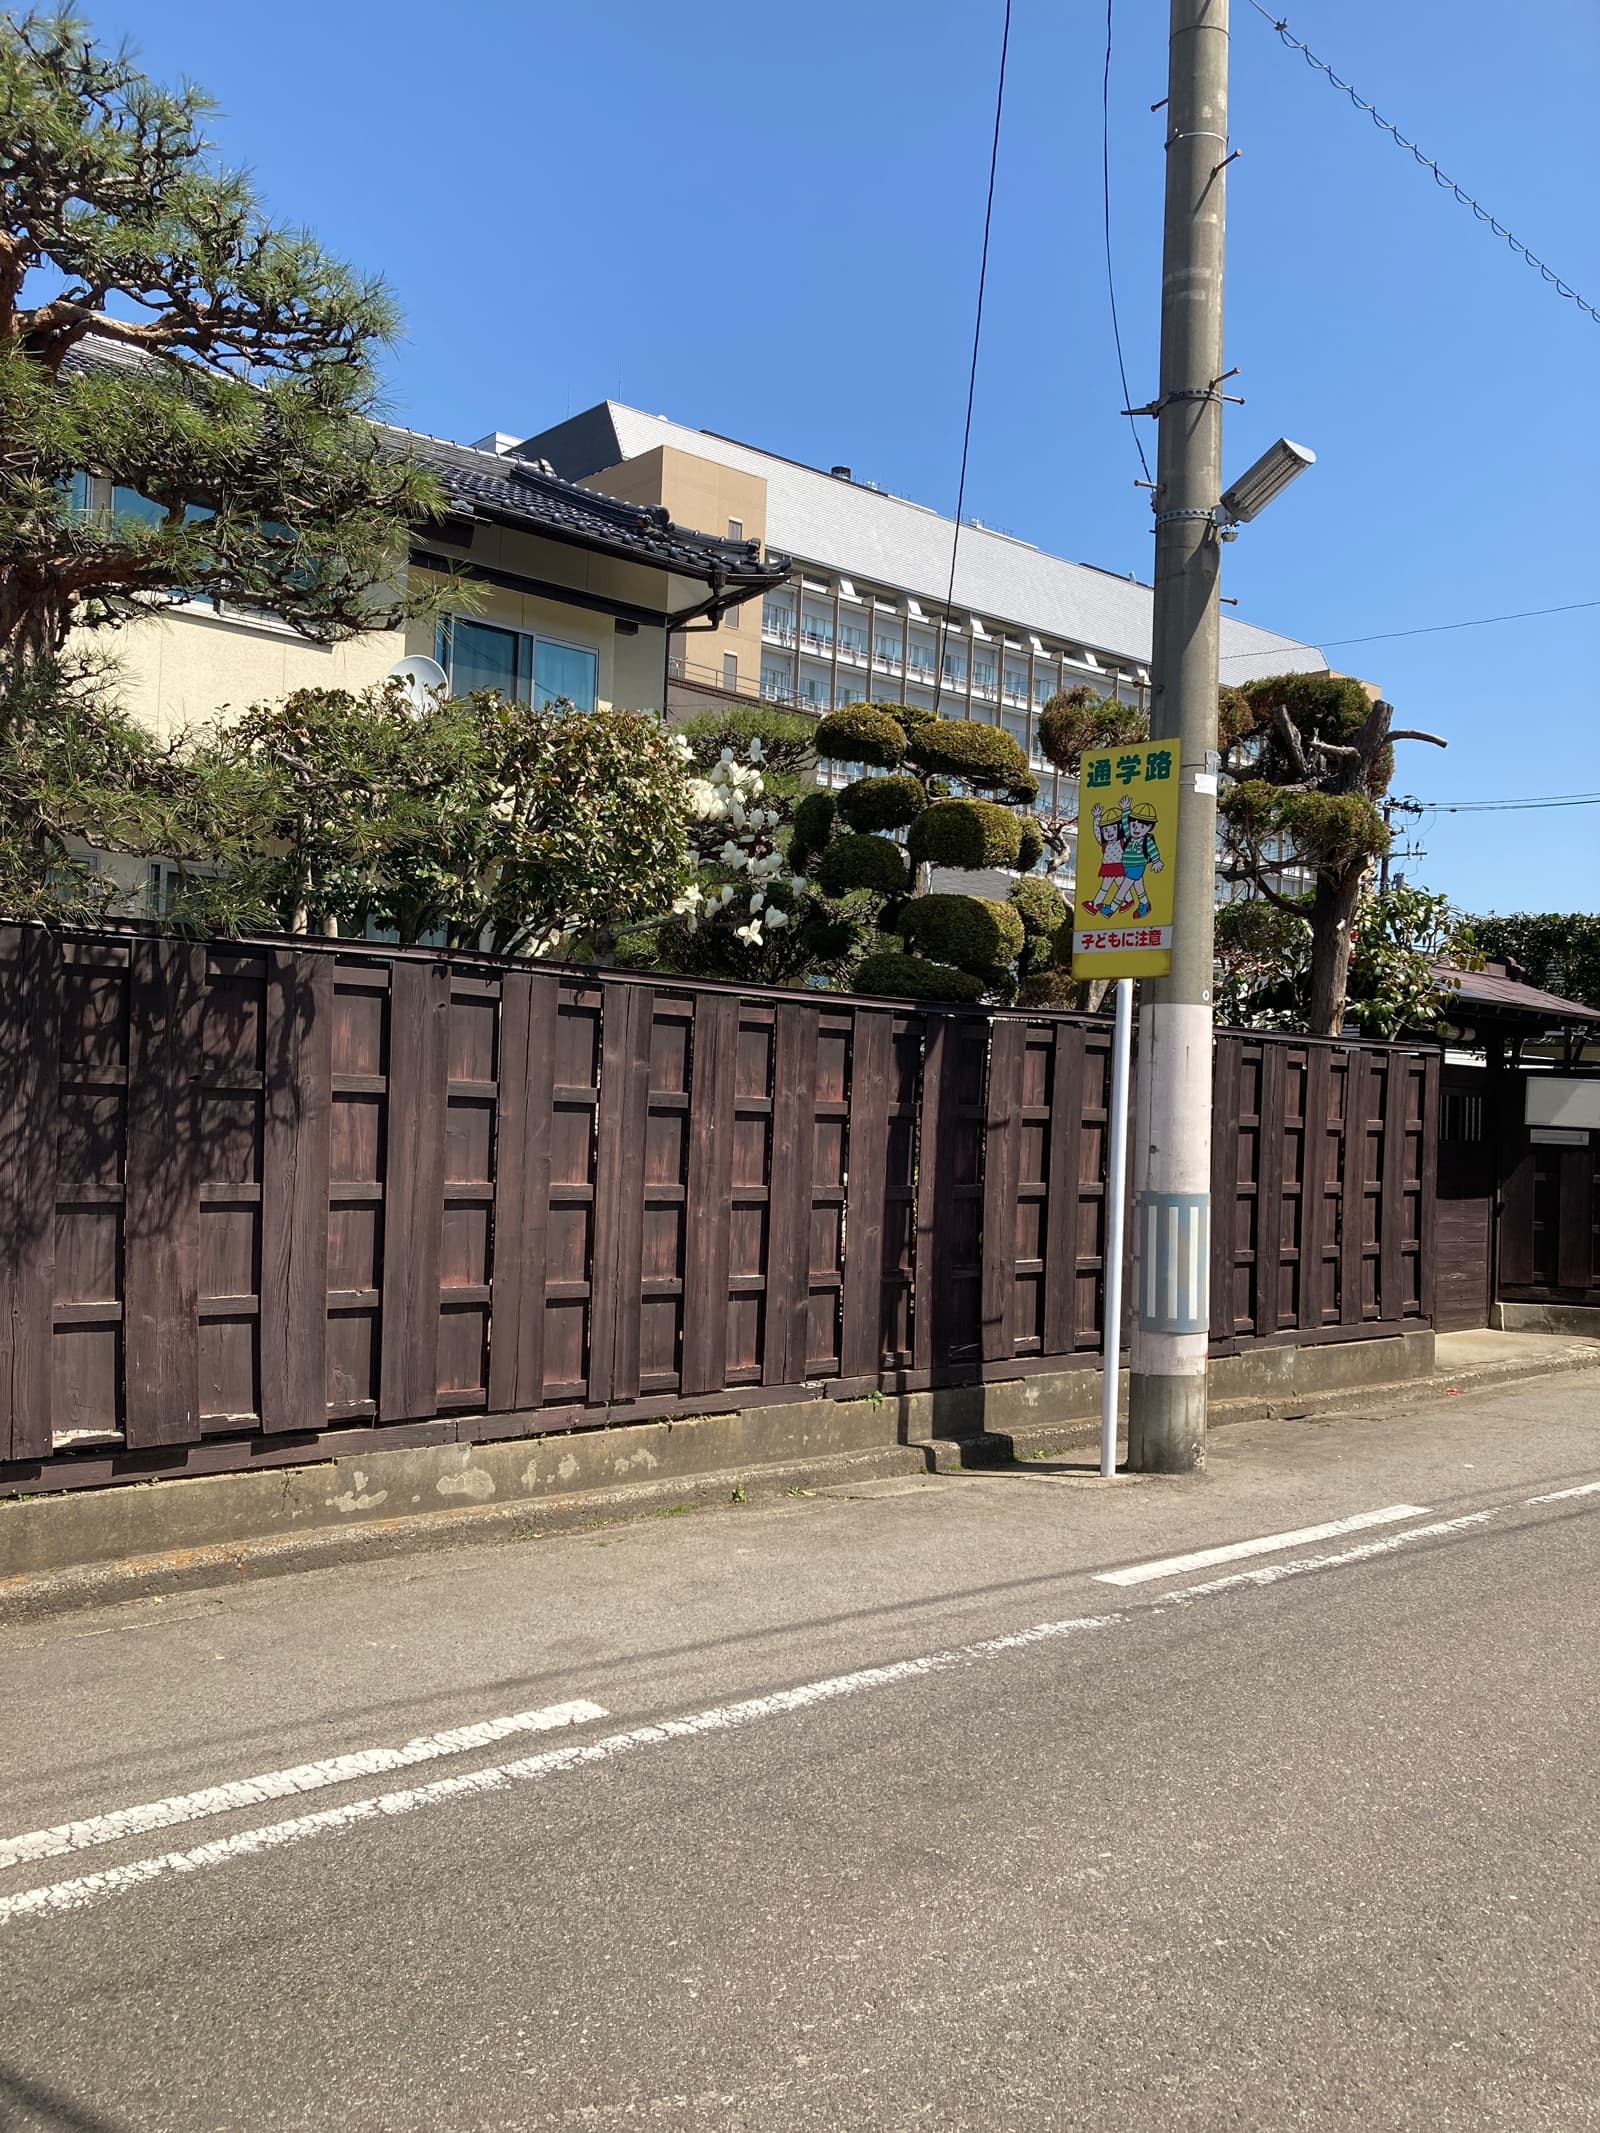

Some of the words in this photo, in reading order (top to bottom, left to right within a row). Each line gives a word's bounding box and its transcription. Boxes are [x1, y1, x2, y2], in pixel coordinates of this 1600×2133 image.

[1087, 750, 1172, 788] 通学路
[1081, 928, 1162, 950] 子どもに注意
